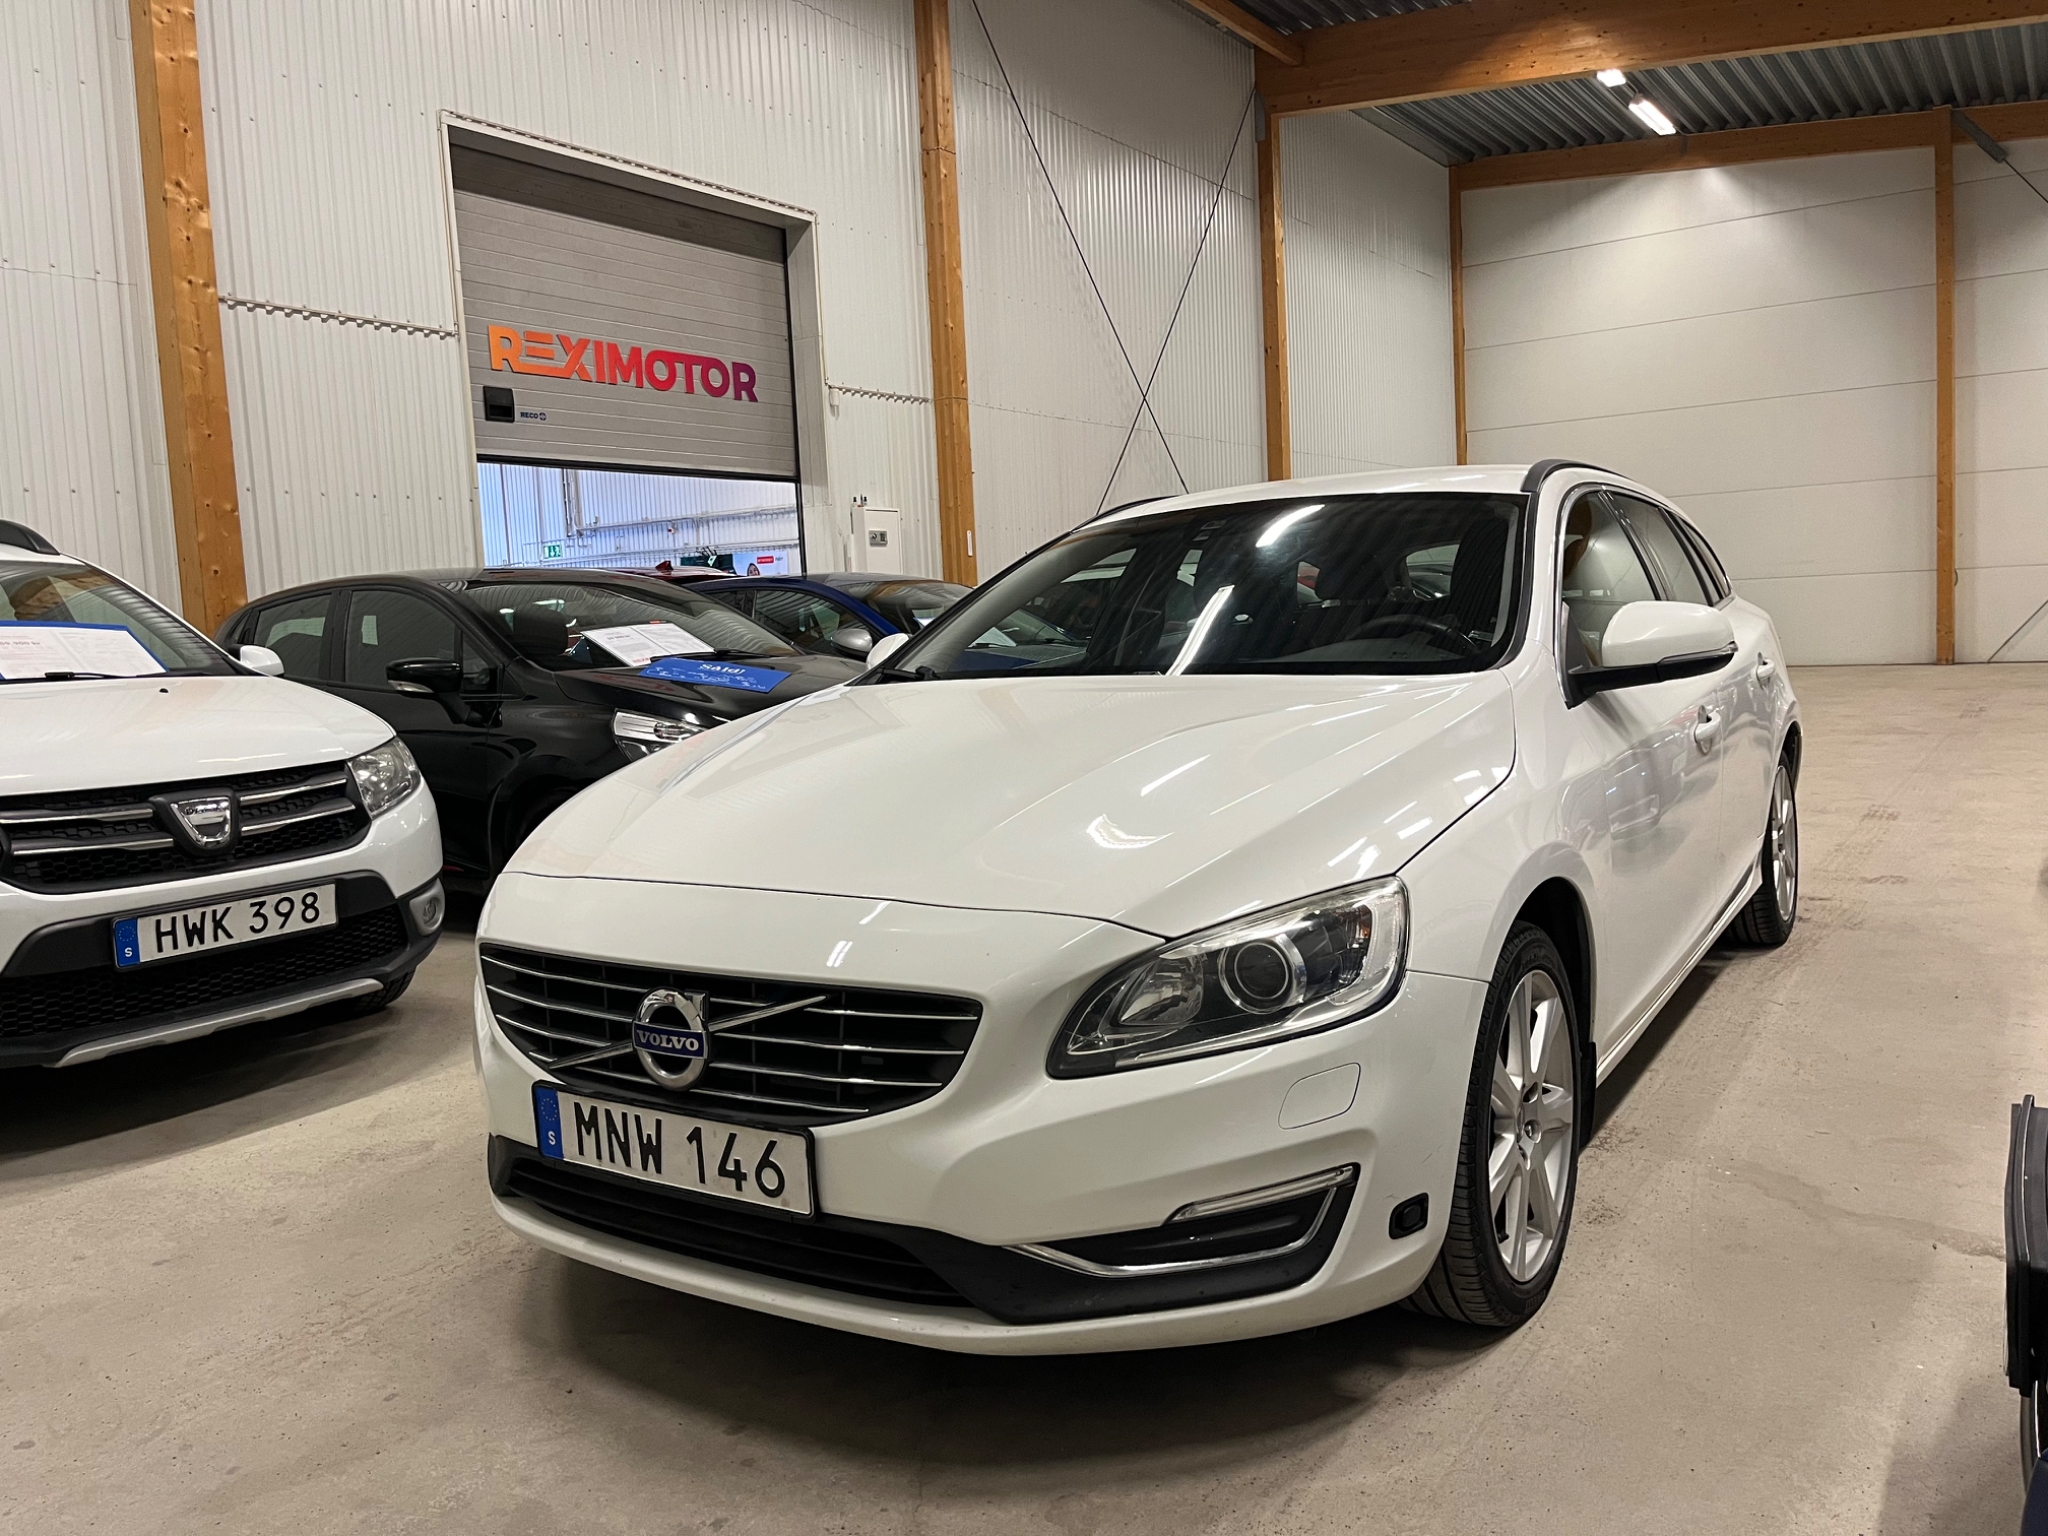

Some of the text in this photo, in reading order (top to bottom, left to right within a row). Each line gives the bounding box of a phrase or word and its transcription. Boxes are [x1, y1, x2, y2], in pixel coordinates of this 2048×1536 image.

[488, 325, 758, 402] REXIMOTOR
[520, 411, 539, 419] RECO
[155, 892, 320, 953] HWK 398
[124, 947, 133, 957] S
[637, 1029, 699, 1051] VOLVO
[548, 1130, 556, 1145] S
[574, 1102, 785, 1198] MNW 146
